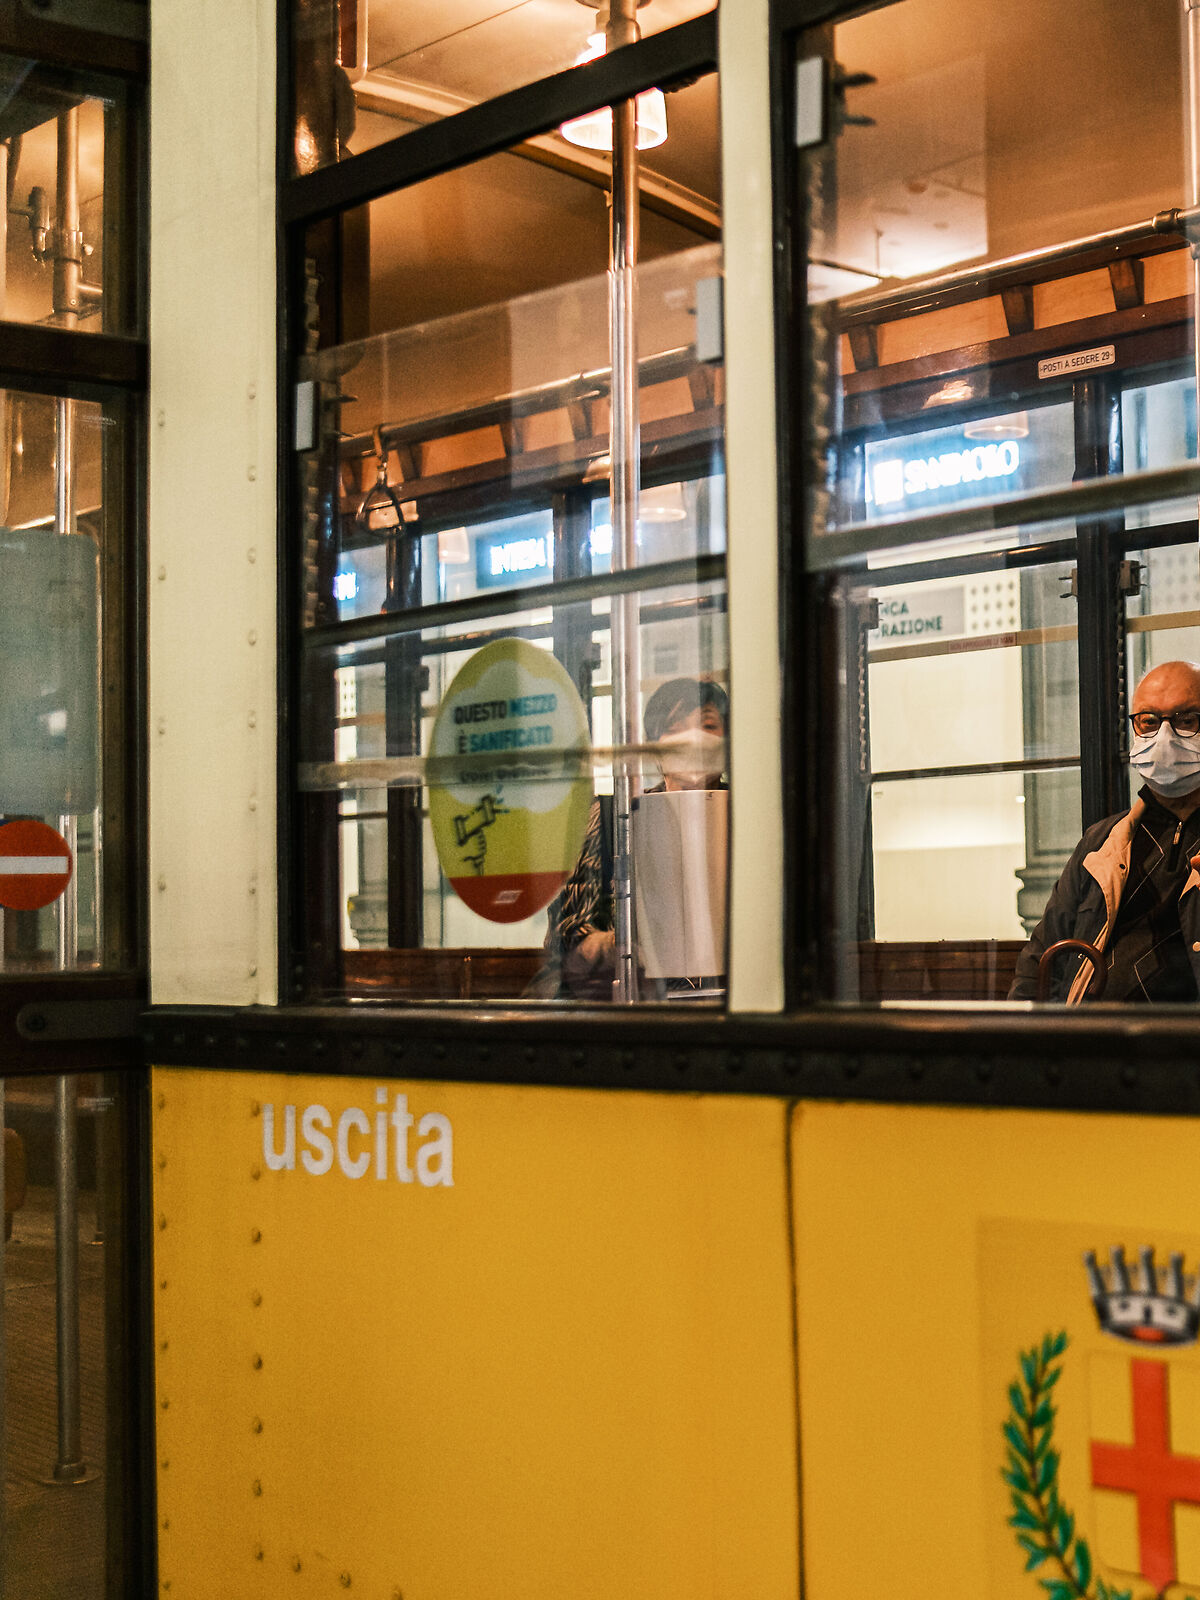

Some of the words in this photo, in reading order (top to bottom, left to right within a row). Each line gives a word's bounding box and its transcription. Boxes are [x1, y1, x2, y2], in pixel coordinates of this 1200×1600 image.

[1043, 361, 1063, 373] POSTI
[1064, 360, 1070, 369] A
[1071, 353, 1100, 367] SEDERE
[1101, 351, 1110, 361] 29
[454, 700, 507, 725] QUESTO
[470, 725, 553, 752] SANIFICATO
[262, 1086, 455, 1188] uscita
